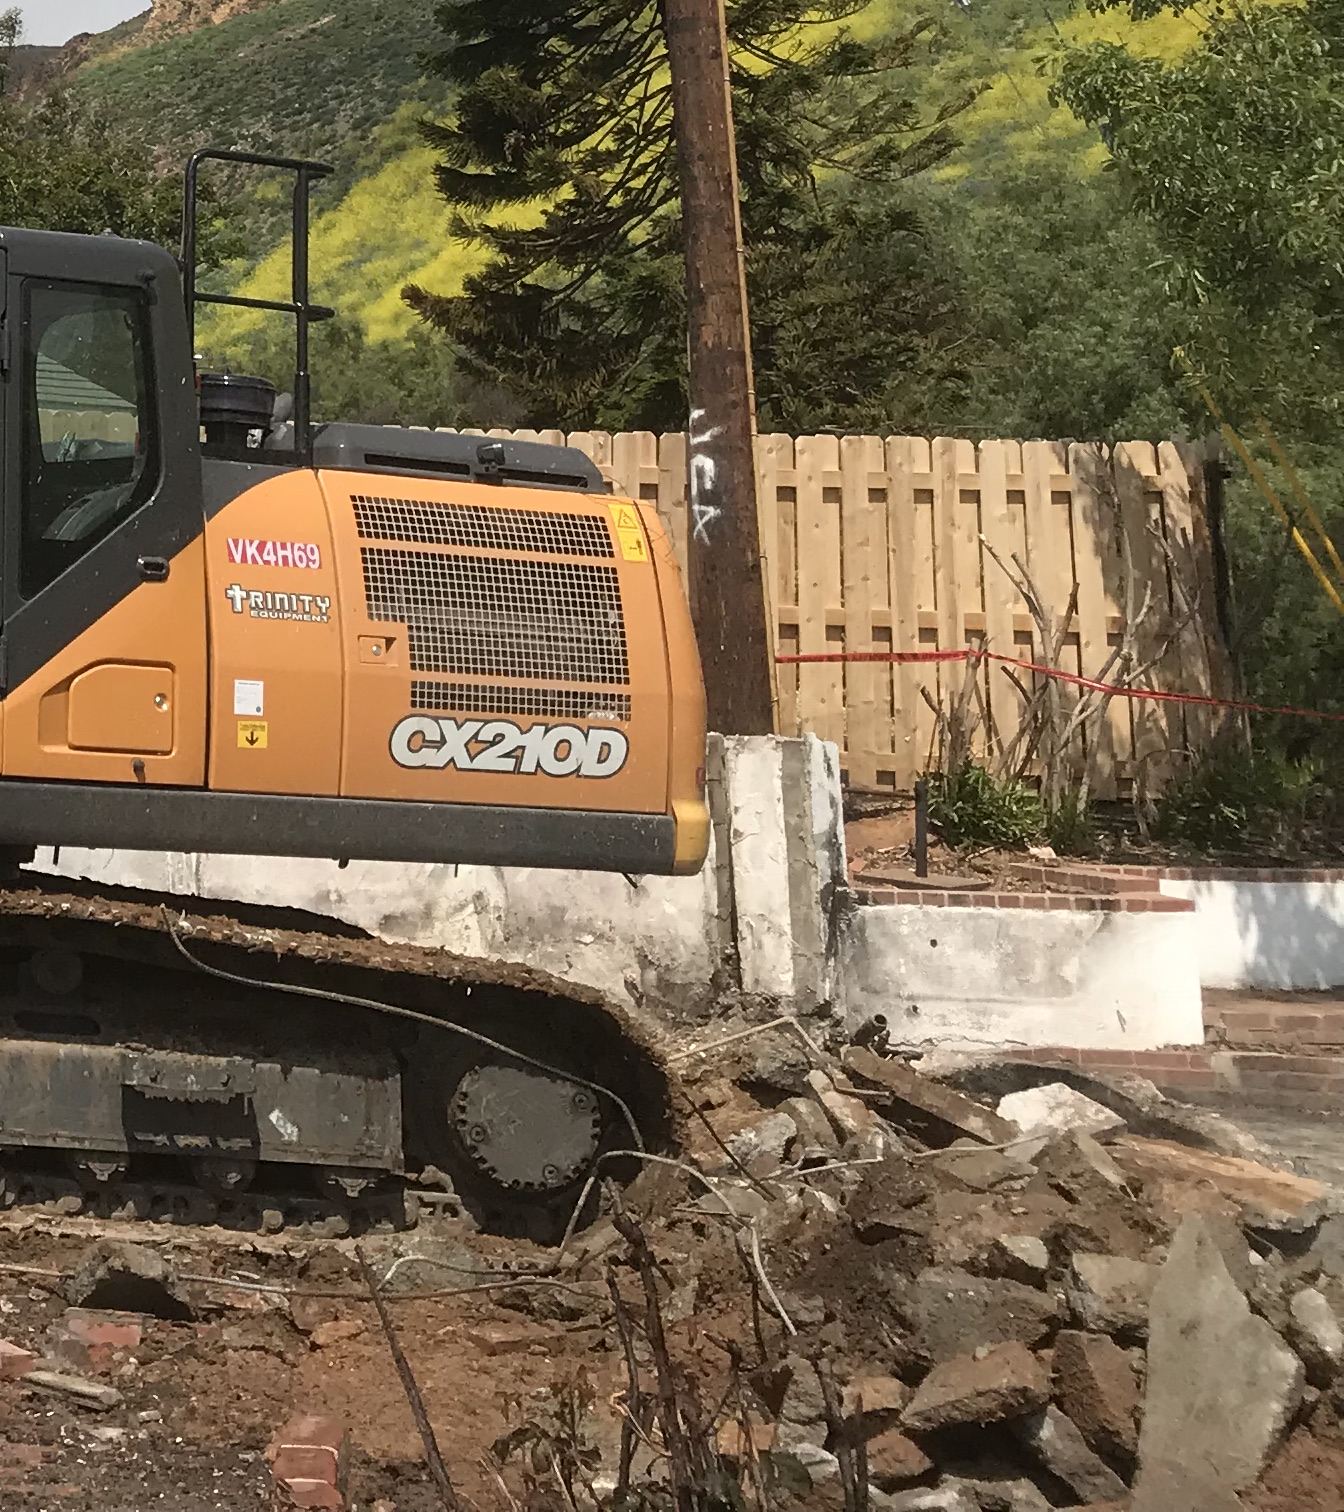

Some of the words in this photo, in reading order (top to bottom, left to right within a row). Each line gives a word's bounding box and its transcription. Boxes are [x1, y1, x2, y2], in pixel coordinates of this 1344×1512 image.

[227, 537, 321, 569] VK4H69
[225, 583, 331, 615] TRINITY
[249, 609, 330, 623] EQUIPMENT
[389, 714, 629, 779] CX210D
